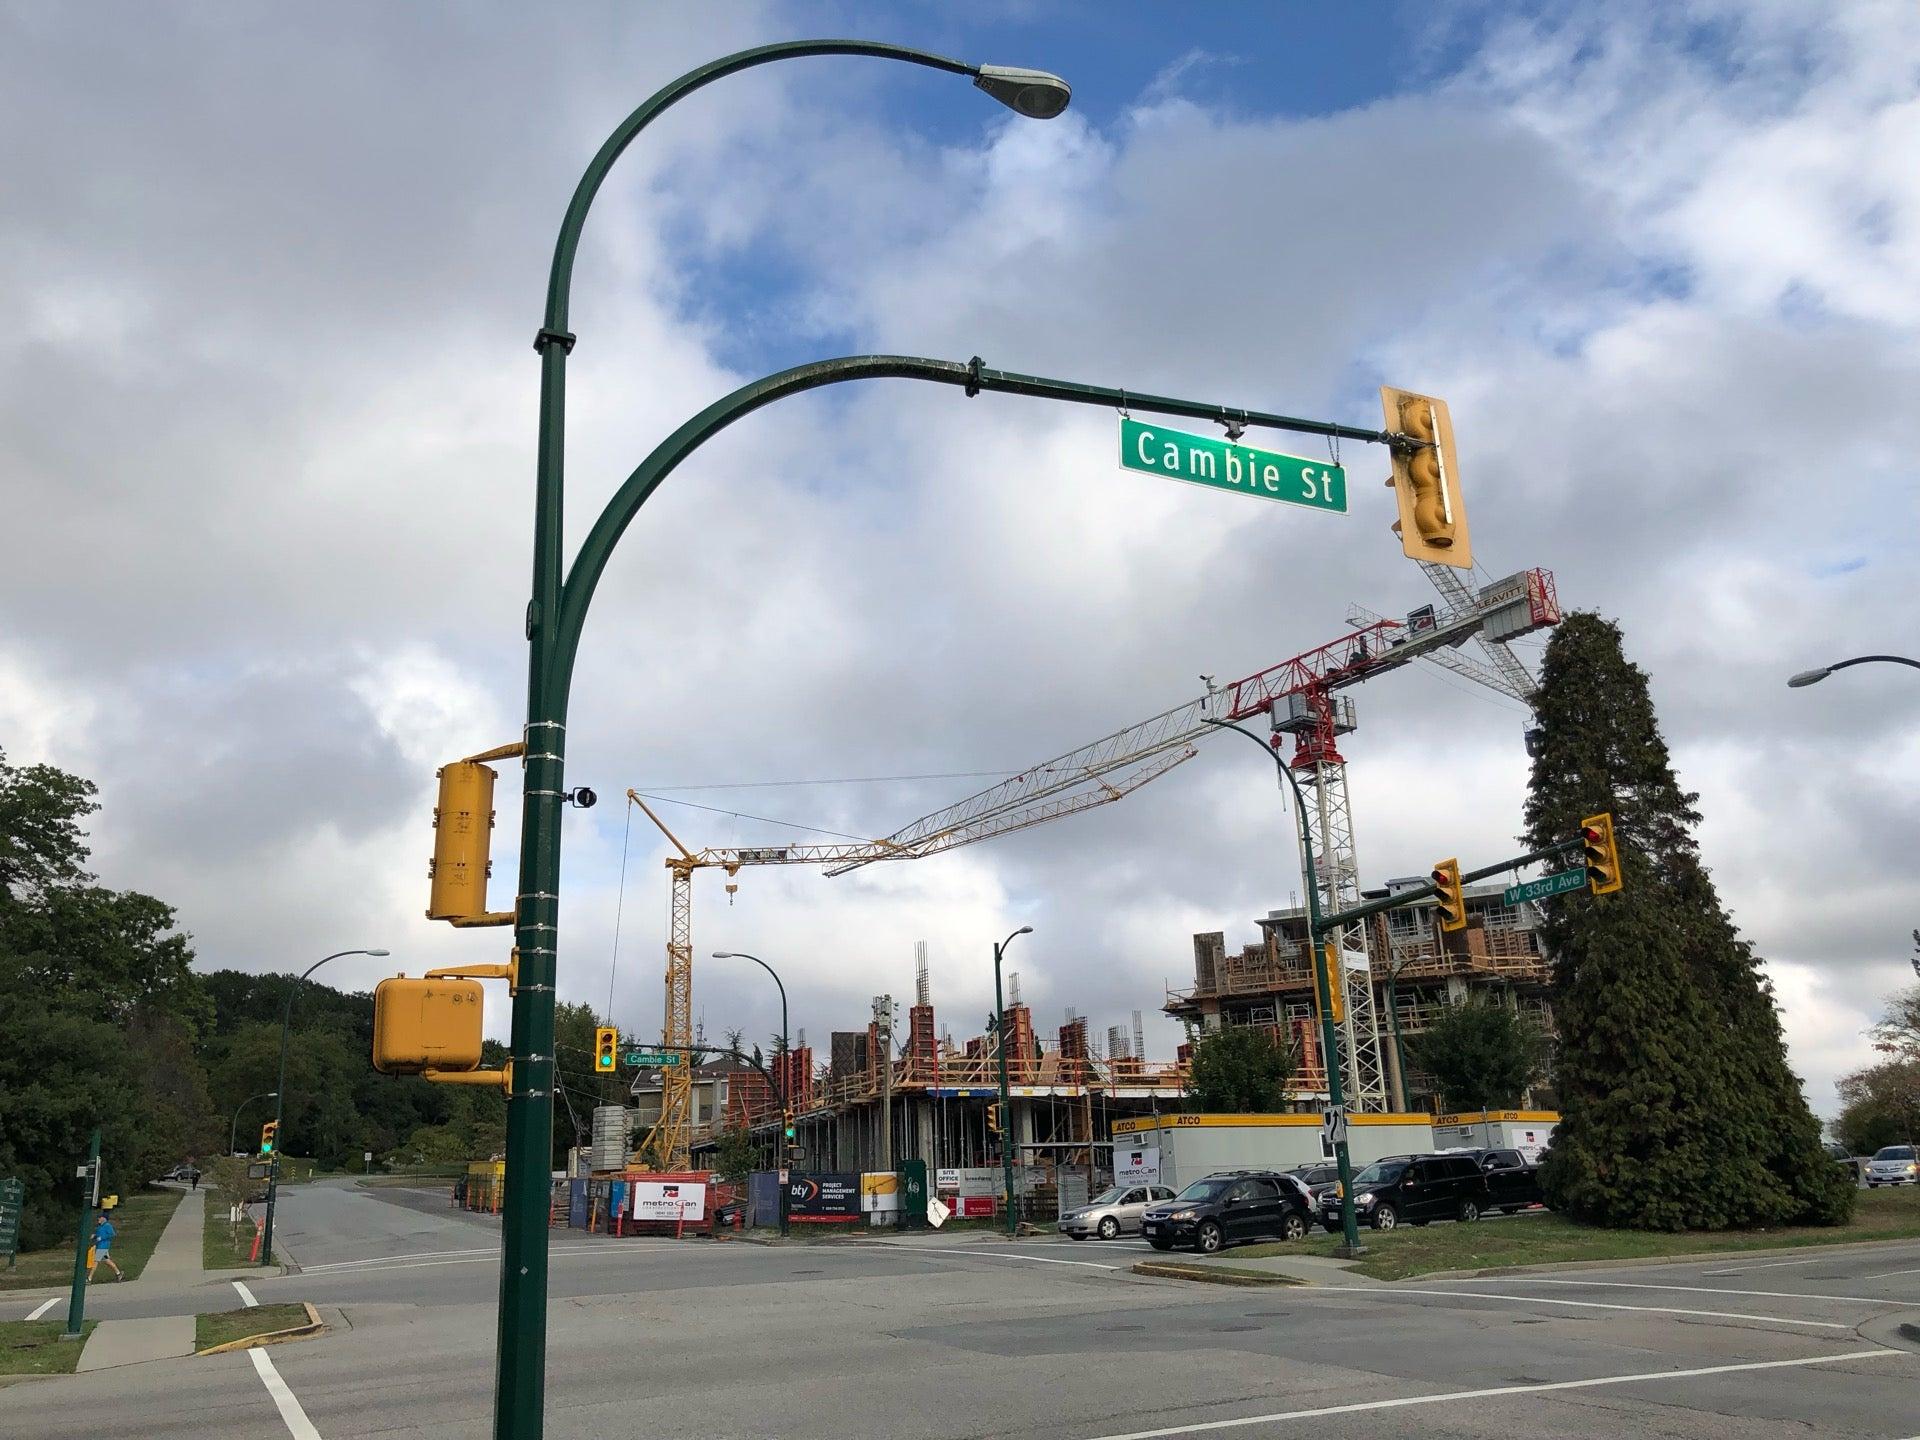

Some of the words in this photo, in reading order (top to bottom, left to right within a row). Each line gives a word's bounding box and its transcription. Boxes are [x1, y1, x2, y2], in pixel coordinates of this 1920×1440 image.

[1138, 431, 1280, 492] Cambie
[1301, 467, 1333, 503] St
[1477, 586, 1522, 609] LEAVITT
[1509, 890, 1521, 901] W
[1525, 880, 1553, 897] 33rd
[1558, 874, 1580, 889] Ave
[630, 1055, 663, 1063] Cambie
[1177, 1116, 1200, 1124] ATCO
[1436, 1116, 1459, 1124] ATCO
[1117, 1122, 1136, 1131] ATCO
[791, 1184, 809, 1198] bty
